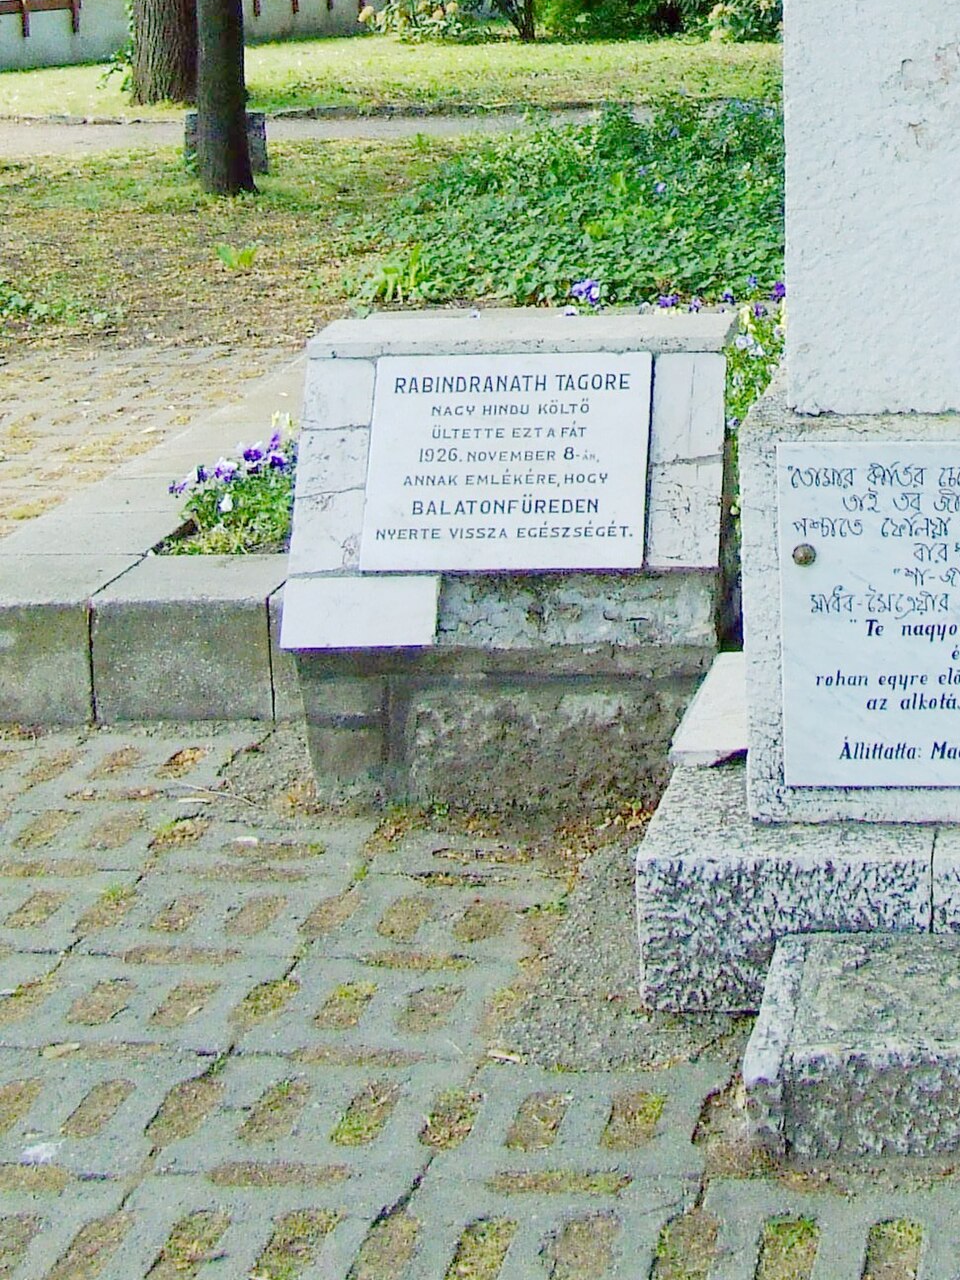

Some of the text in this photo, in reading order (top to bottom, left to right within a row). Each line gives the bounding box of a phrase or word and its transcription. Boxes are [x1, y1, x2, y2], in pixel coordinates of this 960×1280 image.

[394, 373, 631, 394] RABINDRANATH TAGORE
[482, 404, 530, 416] HINDU
[432, 420, 587, 439] ÜLTETTE EZT A FÁT
[419, 448, 463, 463] 1926.
[467, 450, 556, 462] NOVEMBER
[403, 468, 608, 487] ANNAK EMLÉKÉRE, HOGY
[412, 494, 599, 515] BALATONFÜREDEN
[376, 520, 633, 540] NYERTE VISSZA EGÉSZSÉGÉT.
[816, 670, 869, 687] rohan
[866, 697, 888, 710] az
